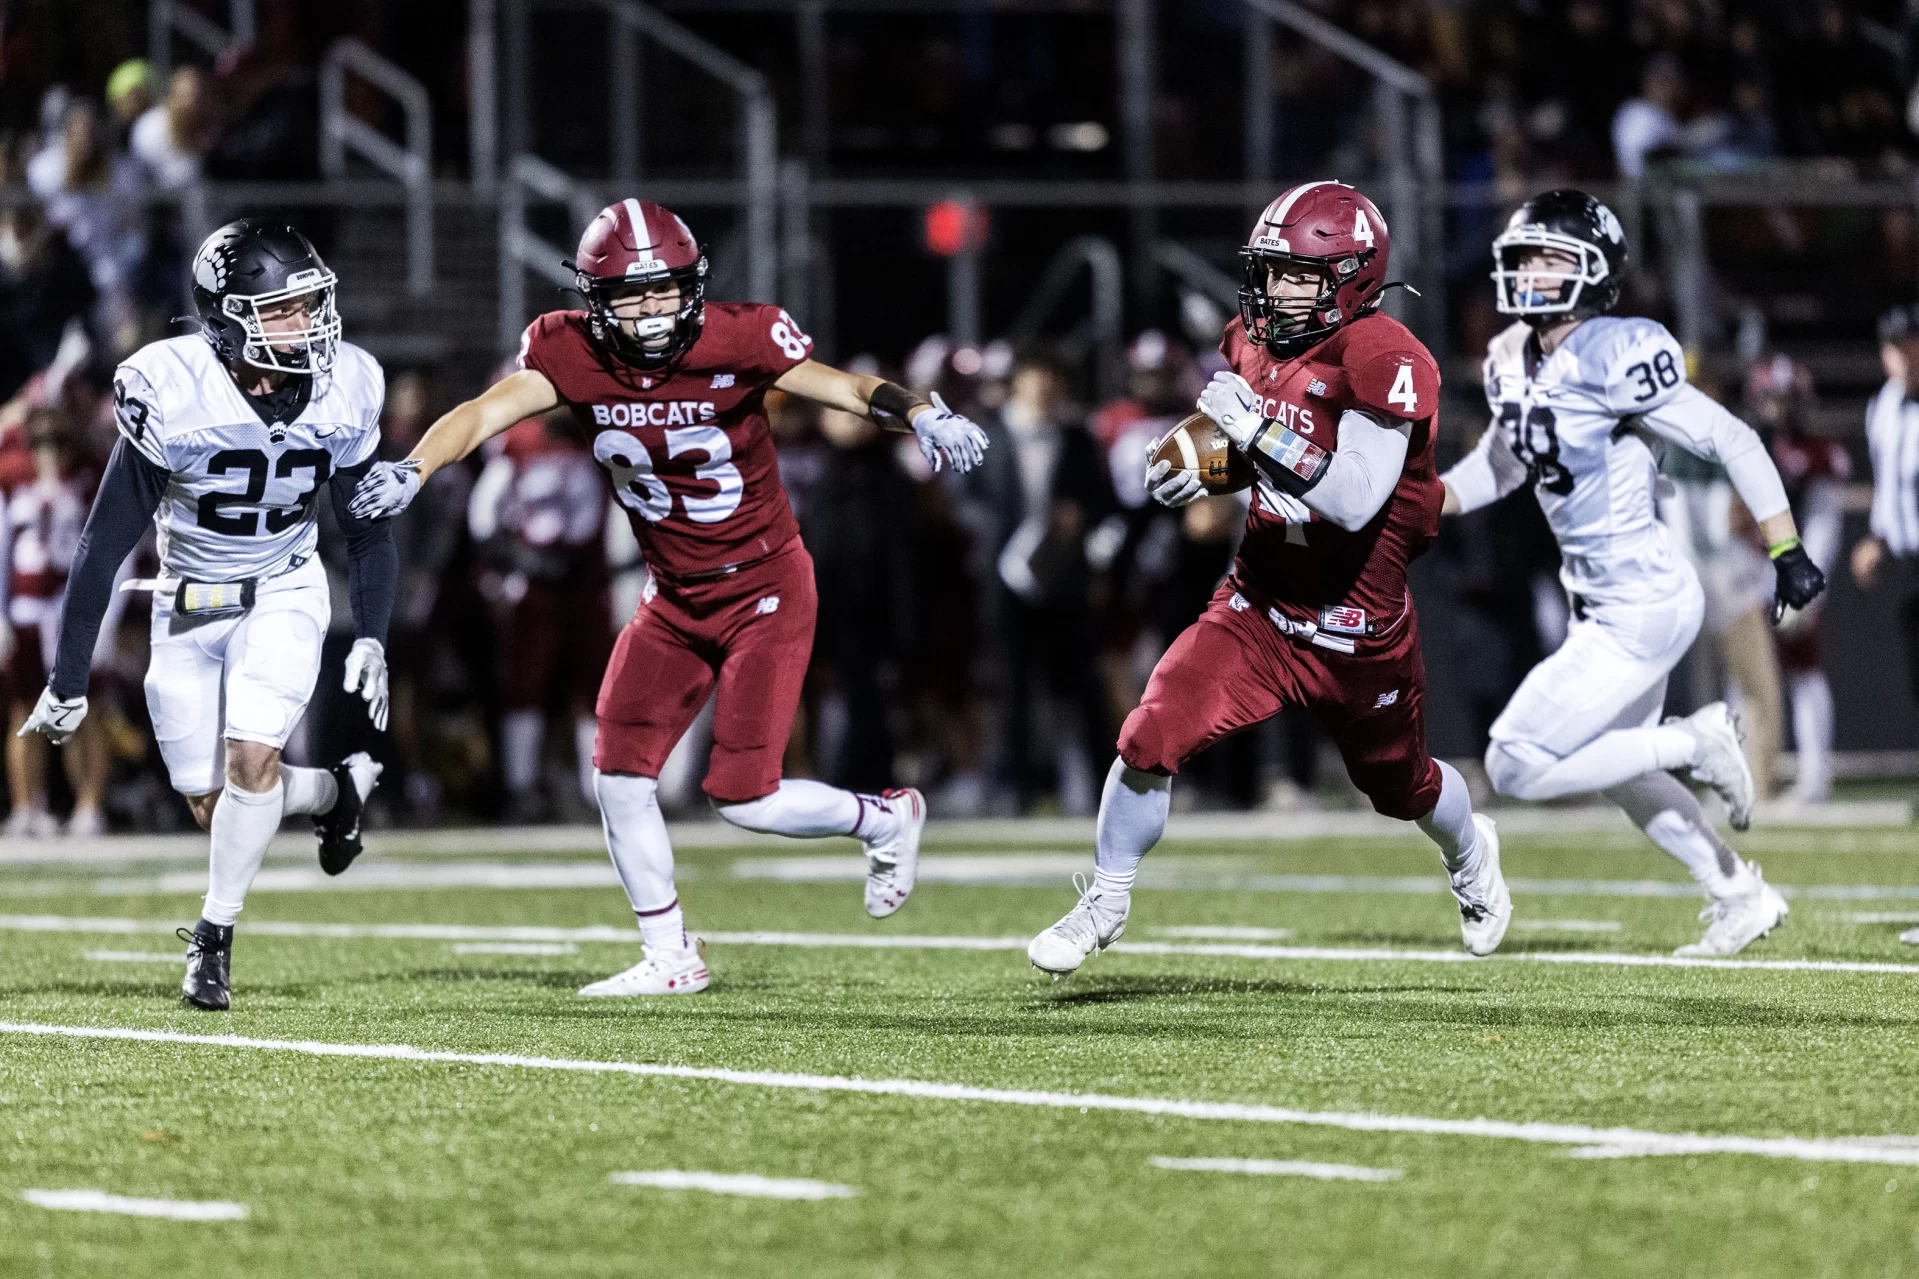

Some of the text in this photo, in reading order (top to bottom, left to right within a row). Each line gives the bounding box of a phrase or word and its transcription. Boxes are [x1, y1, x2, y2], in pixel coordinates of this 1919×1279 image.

[1260, 236, 1280, 247] BATES
[1353, 207, 1374, 248] 4
[1387, 365, 1418, 413] 4
[1625, 349, 1679, 402] 38
[592, 400, 717, 429] BOBCATS
[1253, 393, 1316, 435] BCATS
[197, 448, 333, 537] 23
[593, 425, 744, 523] 83
